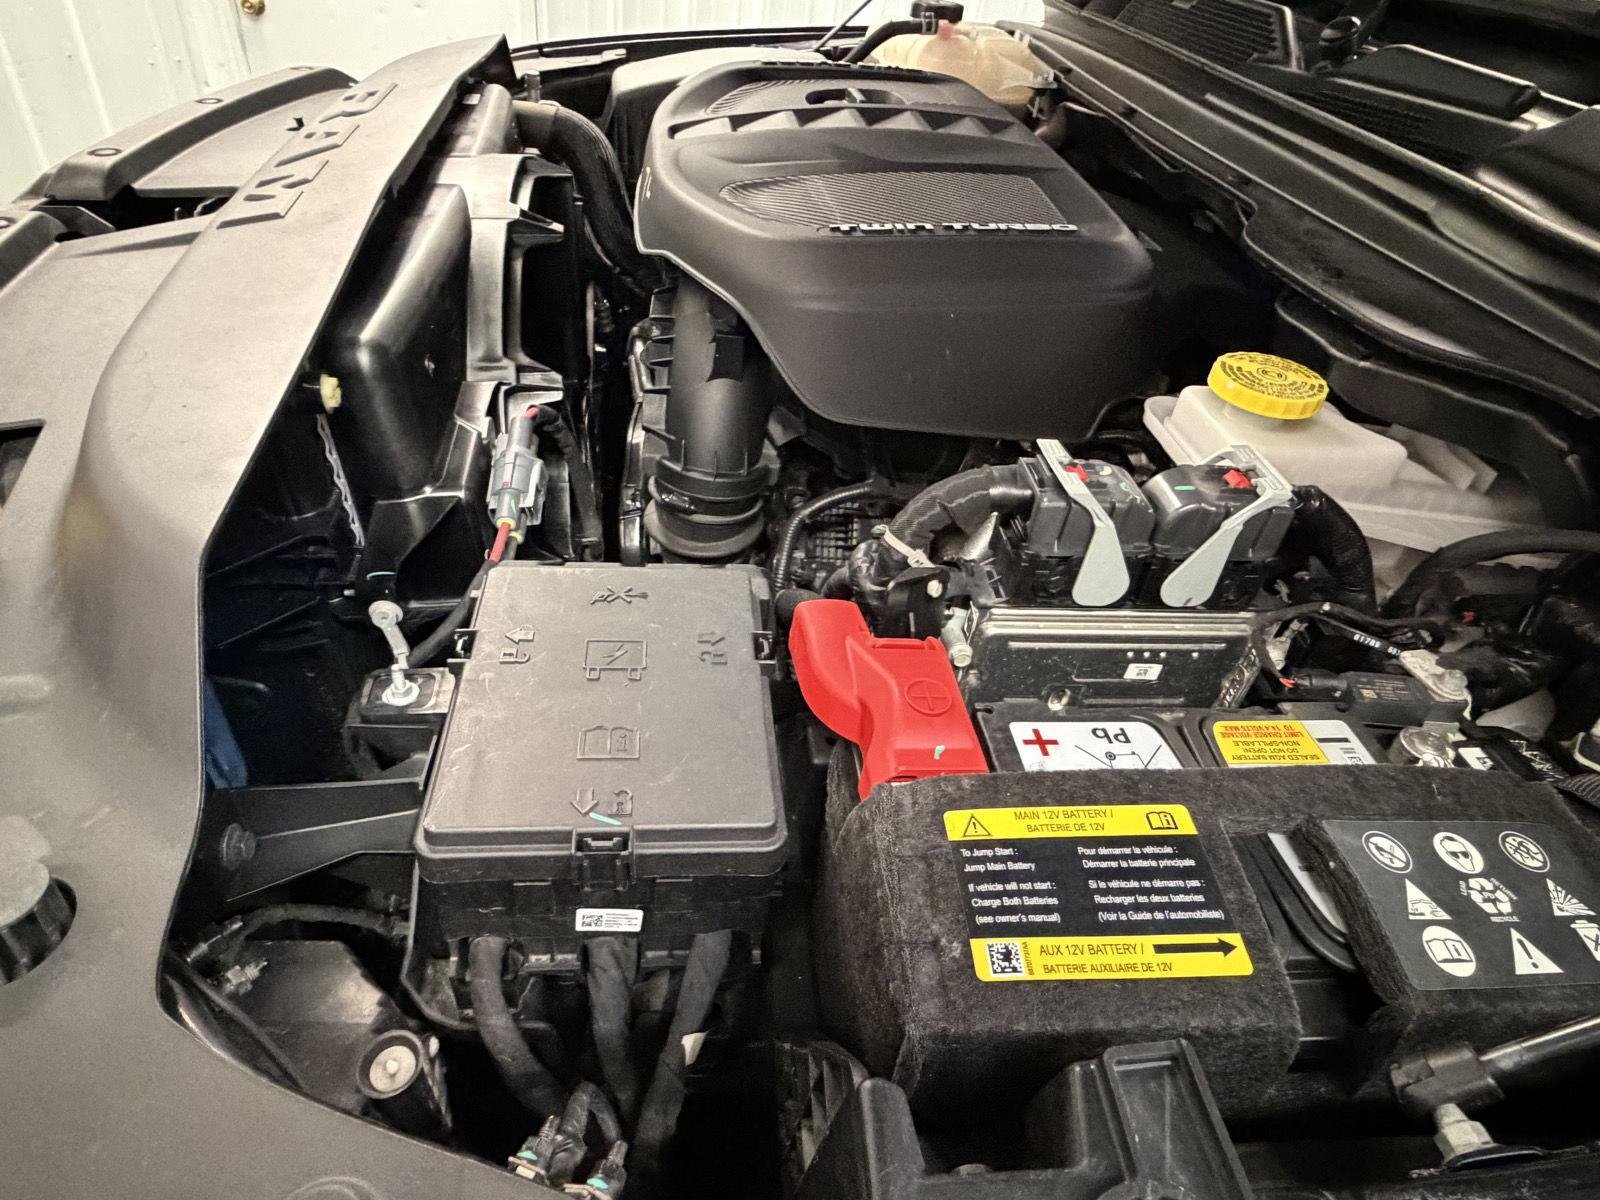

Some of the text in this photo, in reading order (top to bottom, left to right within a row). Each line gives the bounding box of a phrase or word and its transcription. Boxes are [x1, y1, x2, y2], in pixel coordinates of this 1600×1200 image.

[216, 83, 398, 229] RAM
[942, 222, 1079, 232] TURBO
[1091, 728, 1131, 744] Pb
[1014, 810, 1040, 820] MAIN
[1042, 810, 1060, 819] 12V
[1062, 809, 1106, 818] BATTERY
[1026, 822, 1105, 832] BATTERIE DE 12V
[960, 848, 971, 856] To
[972, 848, 993, 857] Jump
[1077, 846, 1096, 855] Pour
[1098, 846, 1131, 854] démarrer
[964, 864, 985, 873] Jump
[1007, 862, 1035, 871] Battery
[1082, 860, 1118, 868] Démarrer
[1128, 859, 1158, 867] batterie
[1158, 858, 1196, 868] principale
[968, 884, 974, 892] If
[975, 883, 1003, 891] vehicle
[1005, 882, 1018, 890] will
[1088, 880, 1097, 888] Si
[1098, 880, 1106, 888] le
[1107, 880, 1140, 888] véhicule
[1152, 879, 1184, 887] démarre
[1186, 880, 1201, 888] pas
[971, 896, 1059, 908] Charge Both Batteries
[1094, 894, 1205, 905] Recharger les deux batteries
[976, 913, 1060, 925] (see owner's manual)
[1098, 909, 1224, 922] (Voir la Guide de l'automobiliste)
[1040, 944, 1063, 956] AUX
[1066, 944, 1084, 955] 12V
[1088, 943, 1137, 955] BATTERY
[1043, 962, 1172, 973] BATTERIE AUXILIAIRE DE 12V
